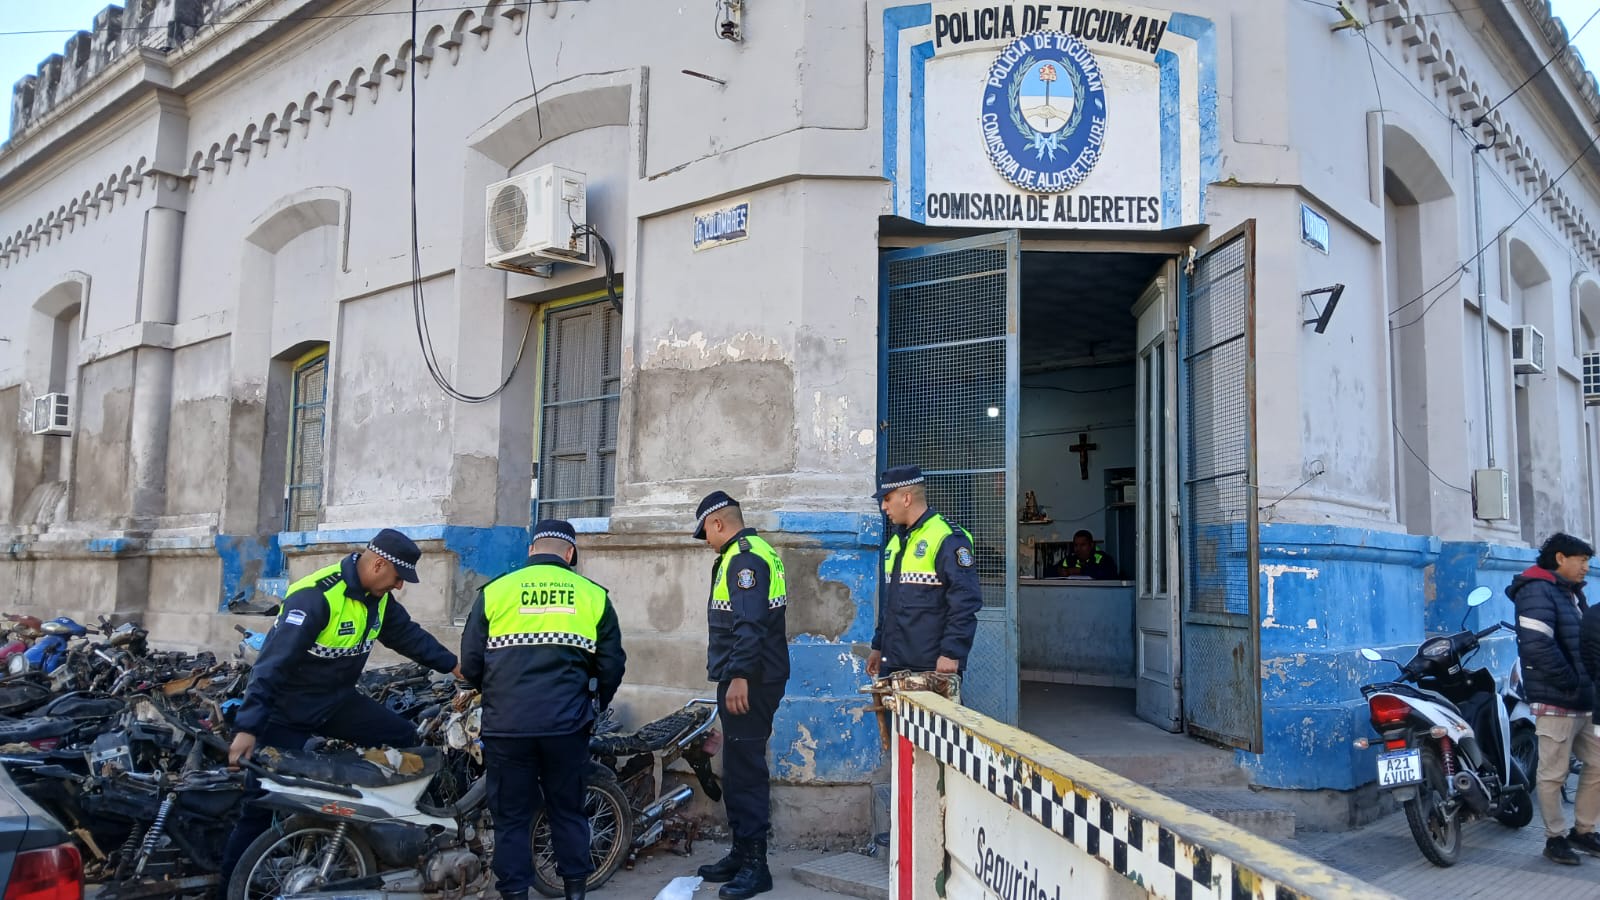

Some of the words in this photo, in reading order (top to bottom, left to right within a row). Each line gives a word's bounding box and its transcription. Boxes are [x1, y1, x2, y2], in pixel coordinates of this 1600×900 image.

[936, 6, 1015, 48] POLICIA
[1021, 4, 1049, 33] DE
[1057, 5, 1168, 54] TUCUMAN
[989, 40, 1031, 88] POLICIA
[1033, 34, 1052, 49] DE
[1053, 35, 1103, 92] TUCUMAN
[982, 112, 1020, 177] COMISARIA
[1018, 167, 1035, 186] DE
[928, 193, 1022, 220] COMISARIA
[1027, 194, 1049, 222] DE
[1053, 195, 1159, 224] ALDERETES
[522, 591, 575, 605] CADETE
[1383, 769, 1415, 784] 4VUC
[1387, 758, 1410, 772] A21
